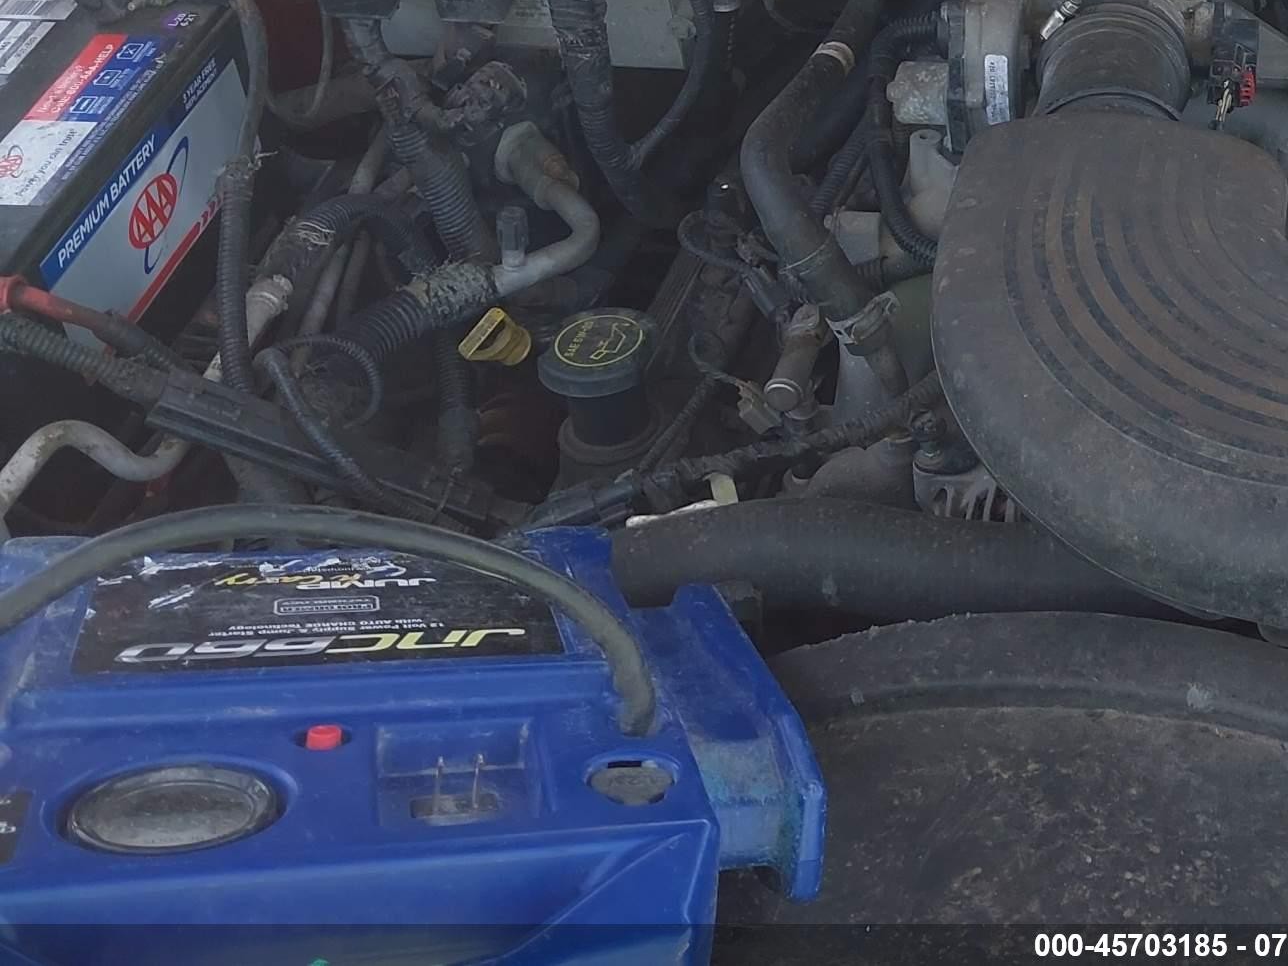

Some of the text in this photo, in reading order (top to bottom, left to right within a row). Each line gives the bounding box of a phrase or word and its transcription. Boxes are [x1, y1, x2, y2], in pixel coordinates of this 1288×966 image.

[57, 193, 110, 269] PREMIUM
[109, 134, 156, 201] BATTERY
[131, 175, 177, 246] AAA
[297, 577, 437, 591] JUMP
[227, 623, 302, 631] Technology
